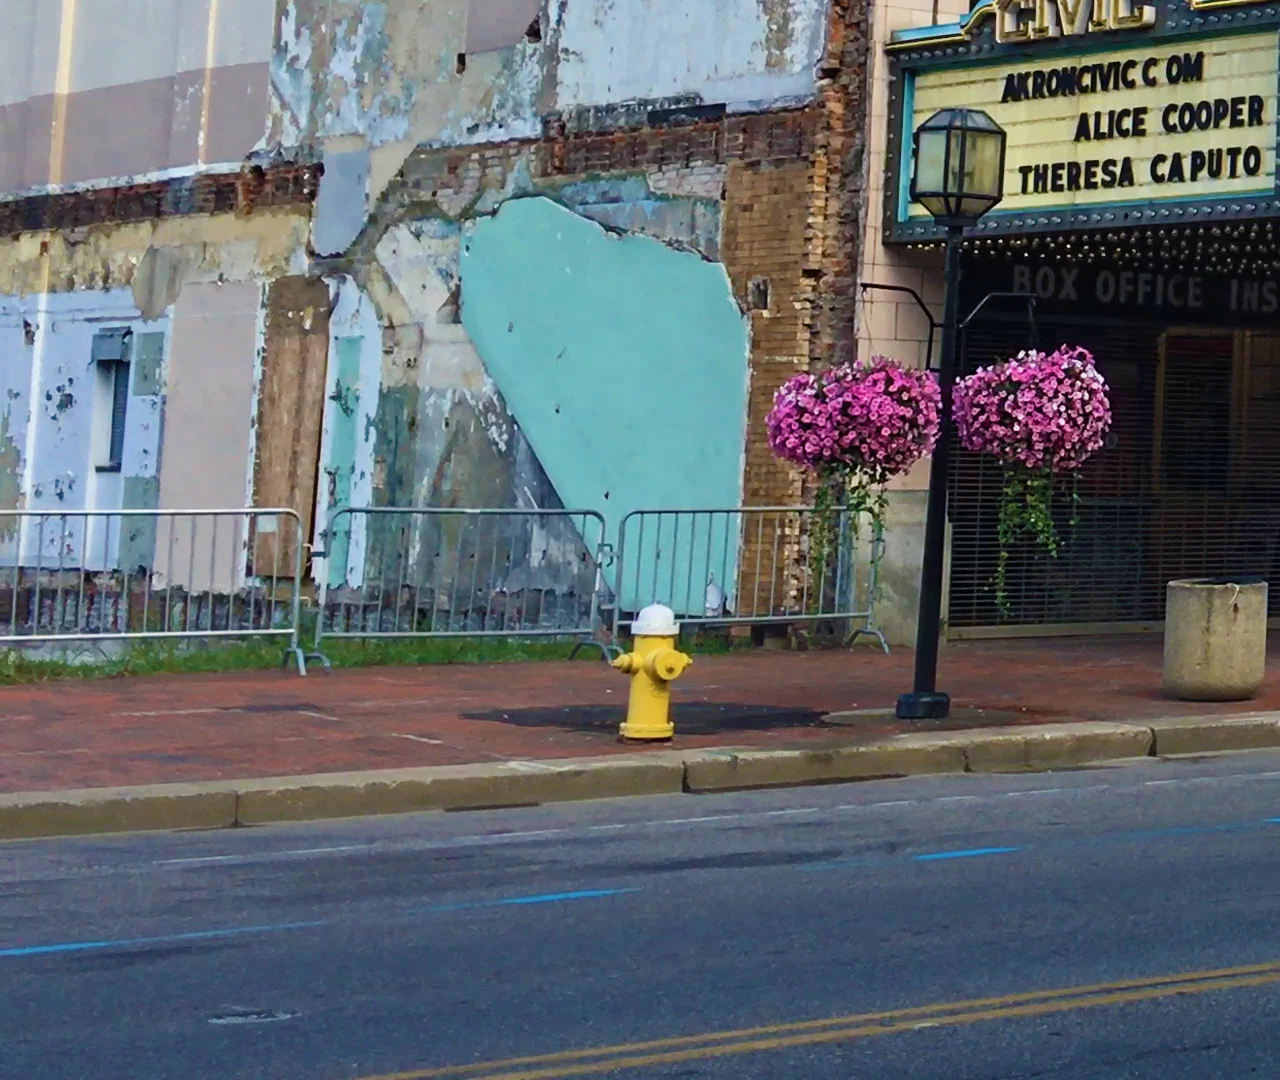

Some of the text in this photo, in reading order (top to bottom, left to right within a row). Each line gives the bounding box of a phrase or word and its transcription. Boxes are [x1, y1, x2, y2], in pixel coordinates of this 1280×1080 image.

[1073, 94, 1264, 143] ALICE COOPER
[1018, 145, 1263, 195] THERESA CAPUTO
[1013, 264, 1080, 302] BOX
[1096, 269, 1204, 308] OFFICE
